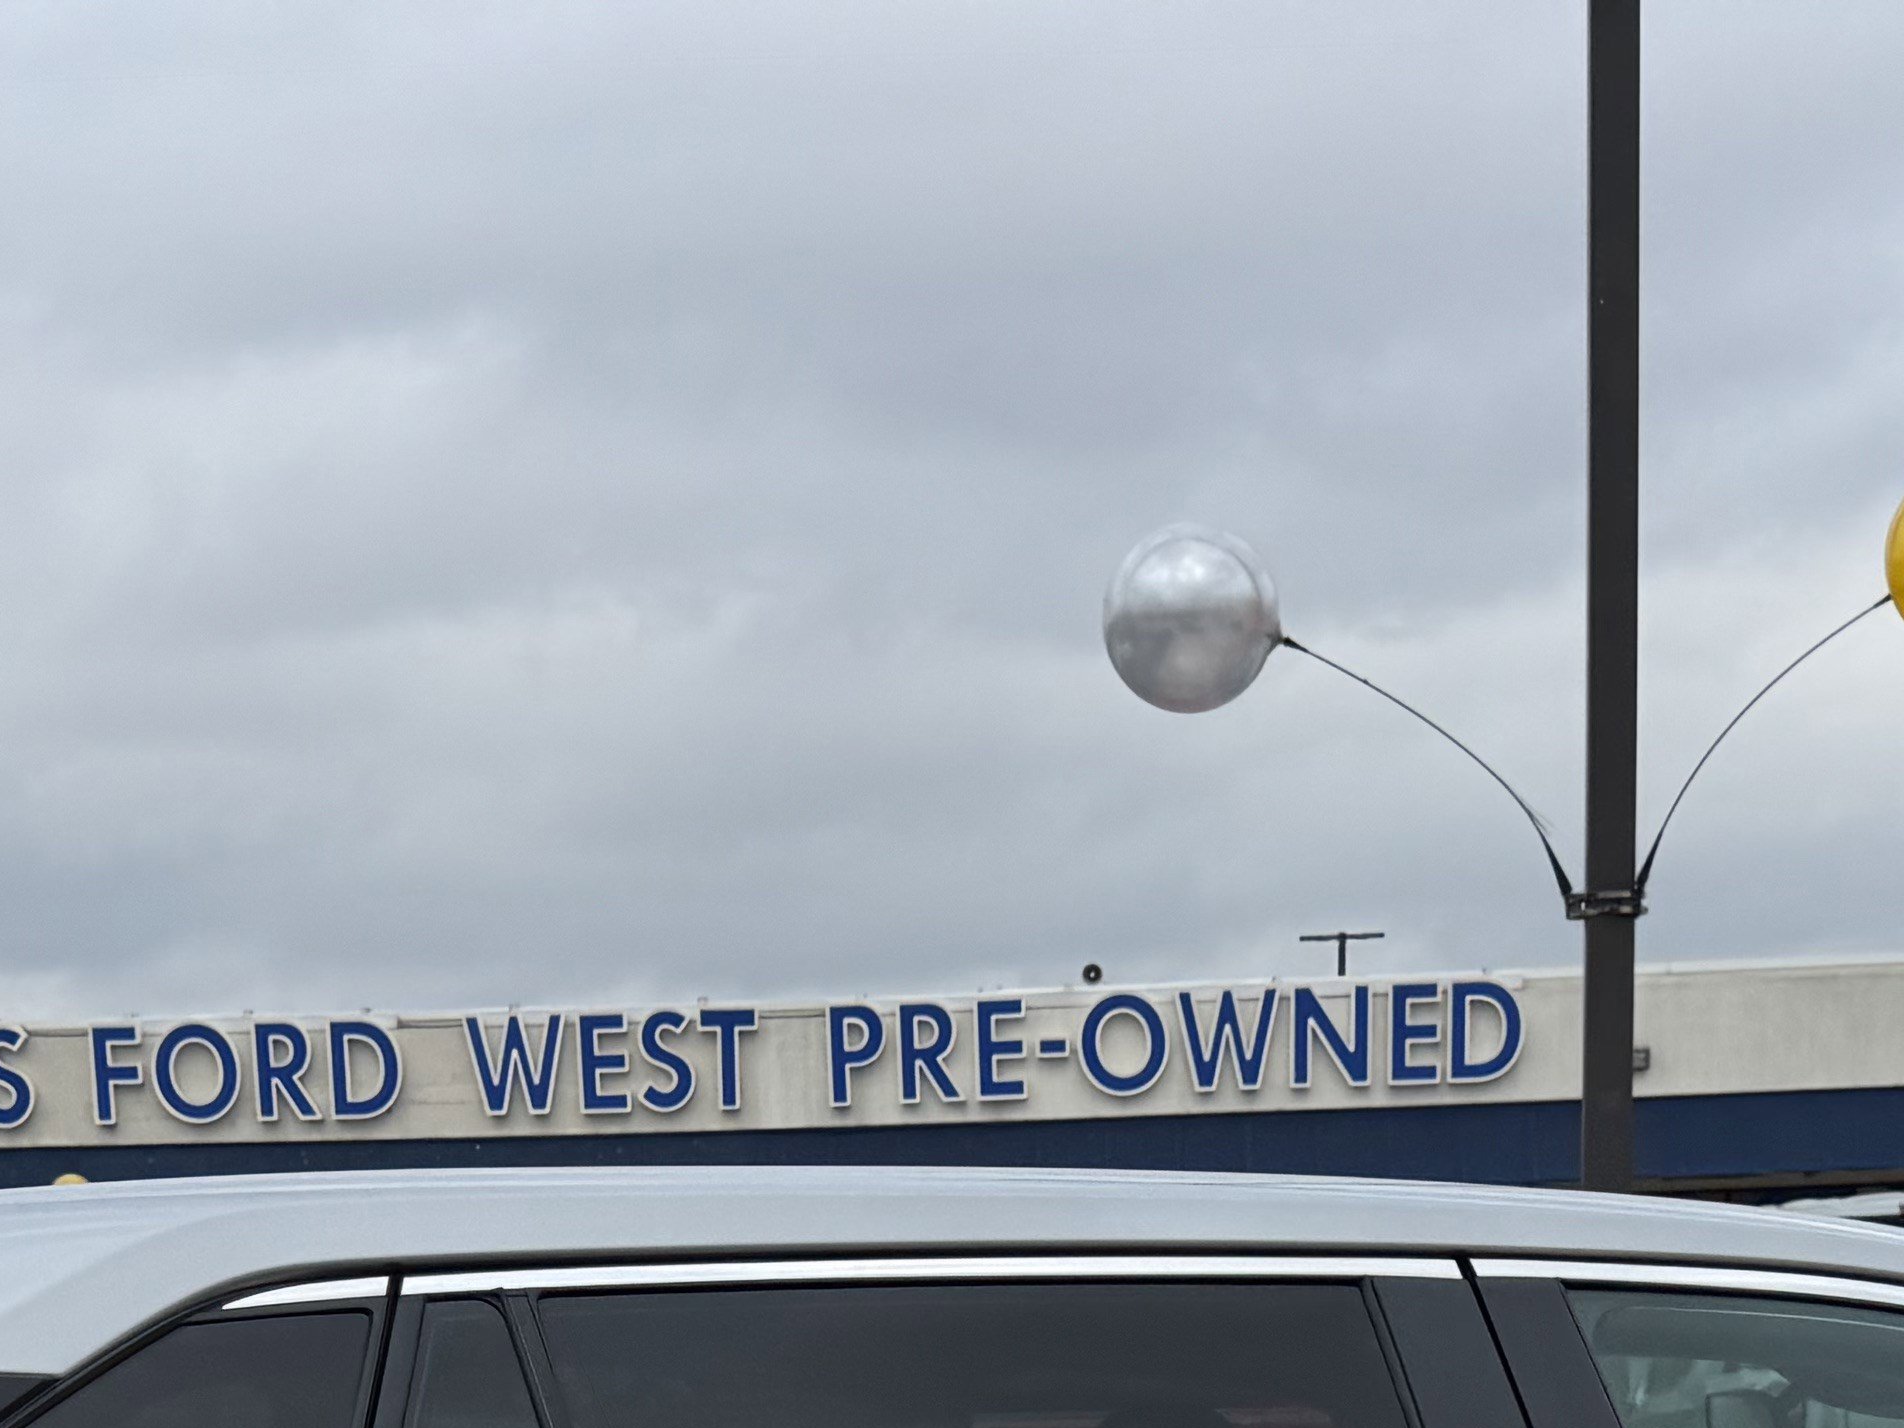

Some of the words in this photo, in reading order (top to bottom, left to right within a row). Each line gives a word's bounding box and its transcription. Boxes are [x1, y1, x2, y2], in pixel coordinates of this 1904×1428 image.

[90, 1018, 404, 1126] FORD
[463, 1008, 759, 1117] WEST
[826, 979, 1526, 1109] PRE-OWNED
